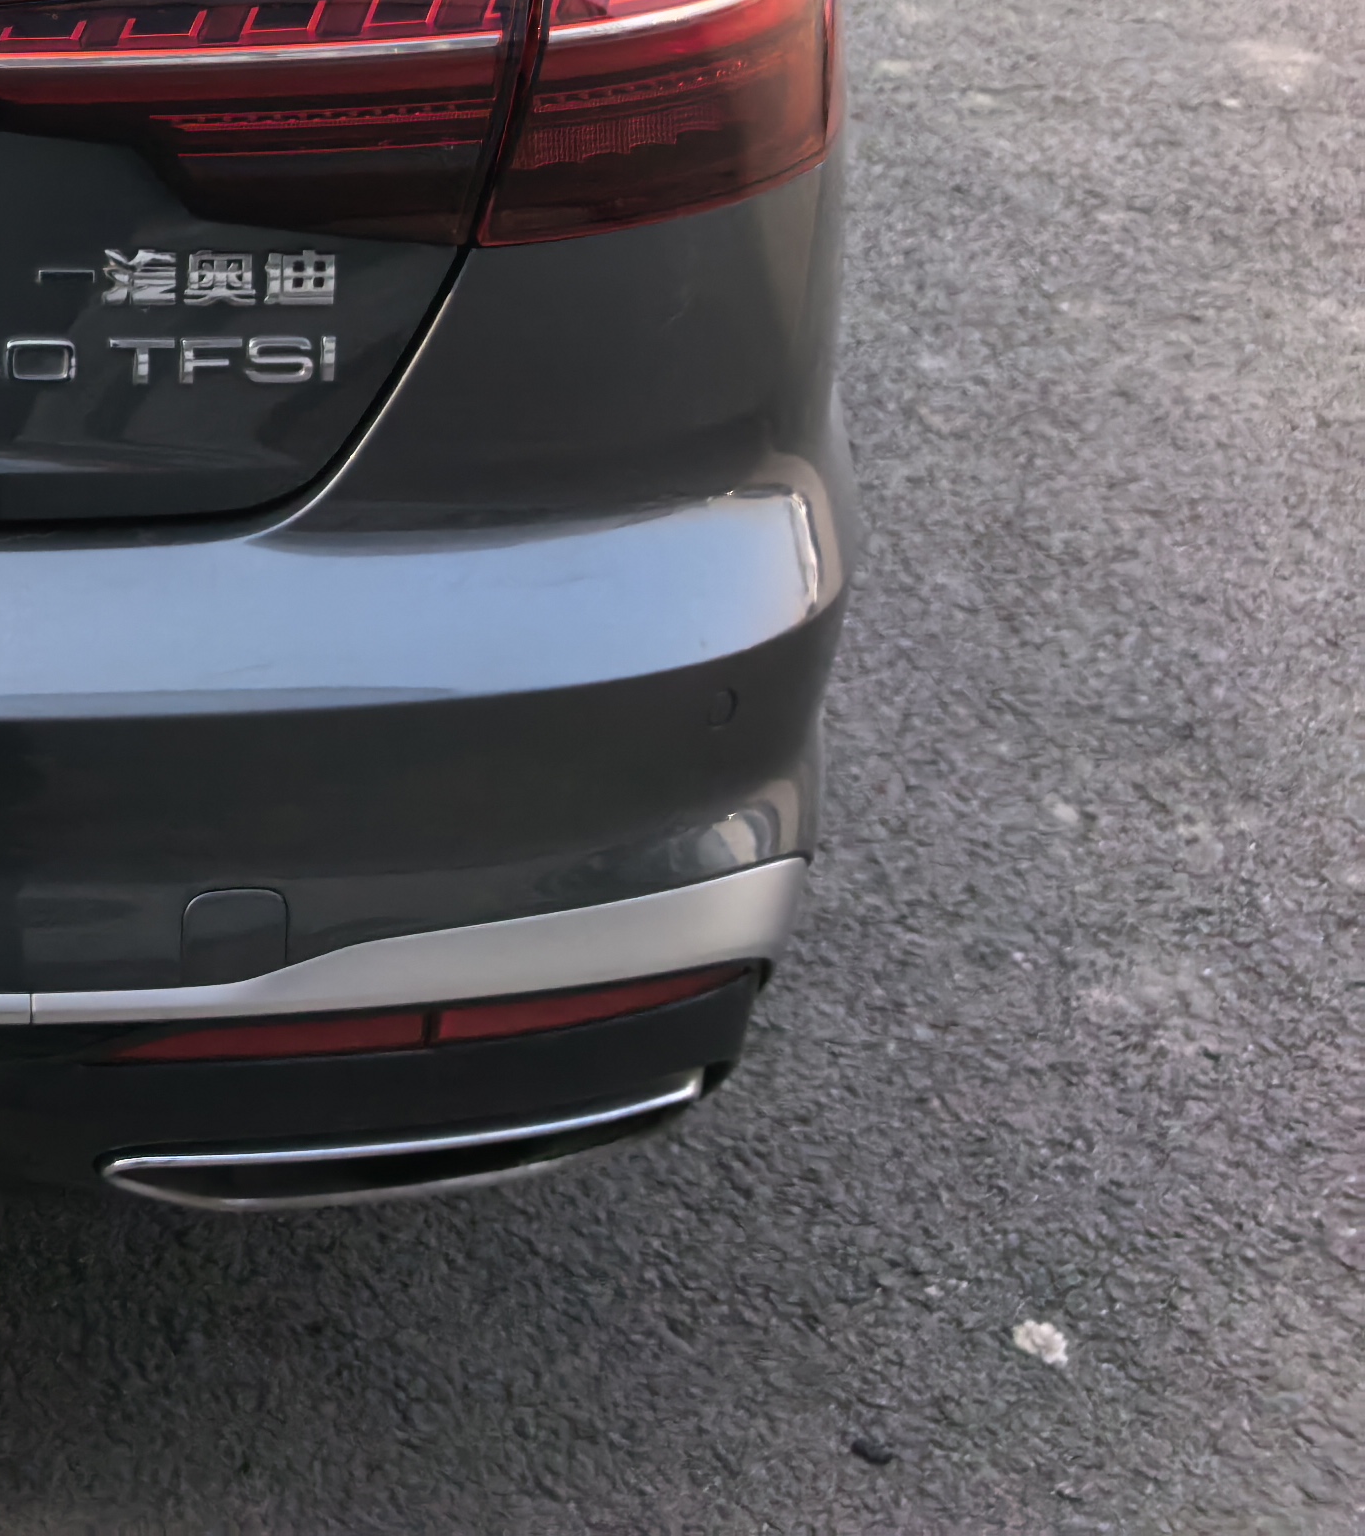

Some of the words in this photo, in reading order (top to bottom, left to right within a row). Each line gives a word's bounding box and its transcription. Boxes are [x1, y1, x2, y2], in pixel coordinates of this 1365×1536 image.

[36, 249, 336, 307] 一汽奥迪
[108, 335, 337, 384] TFSI
